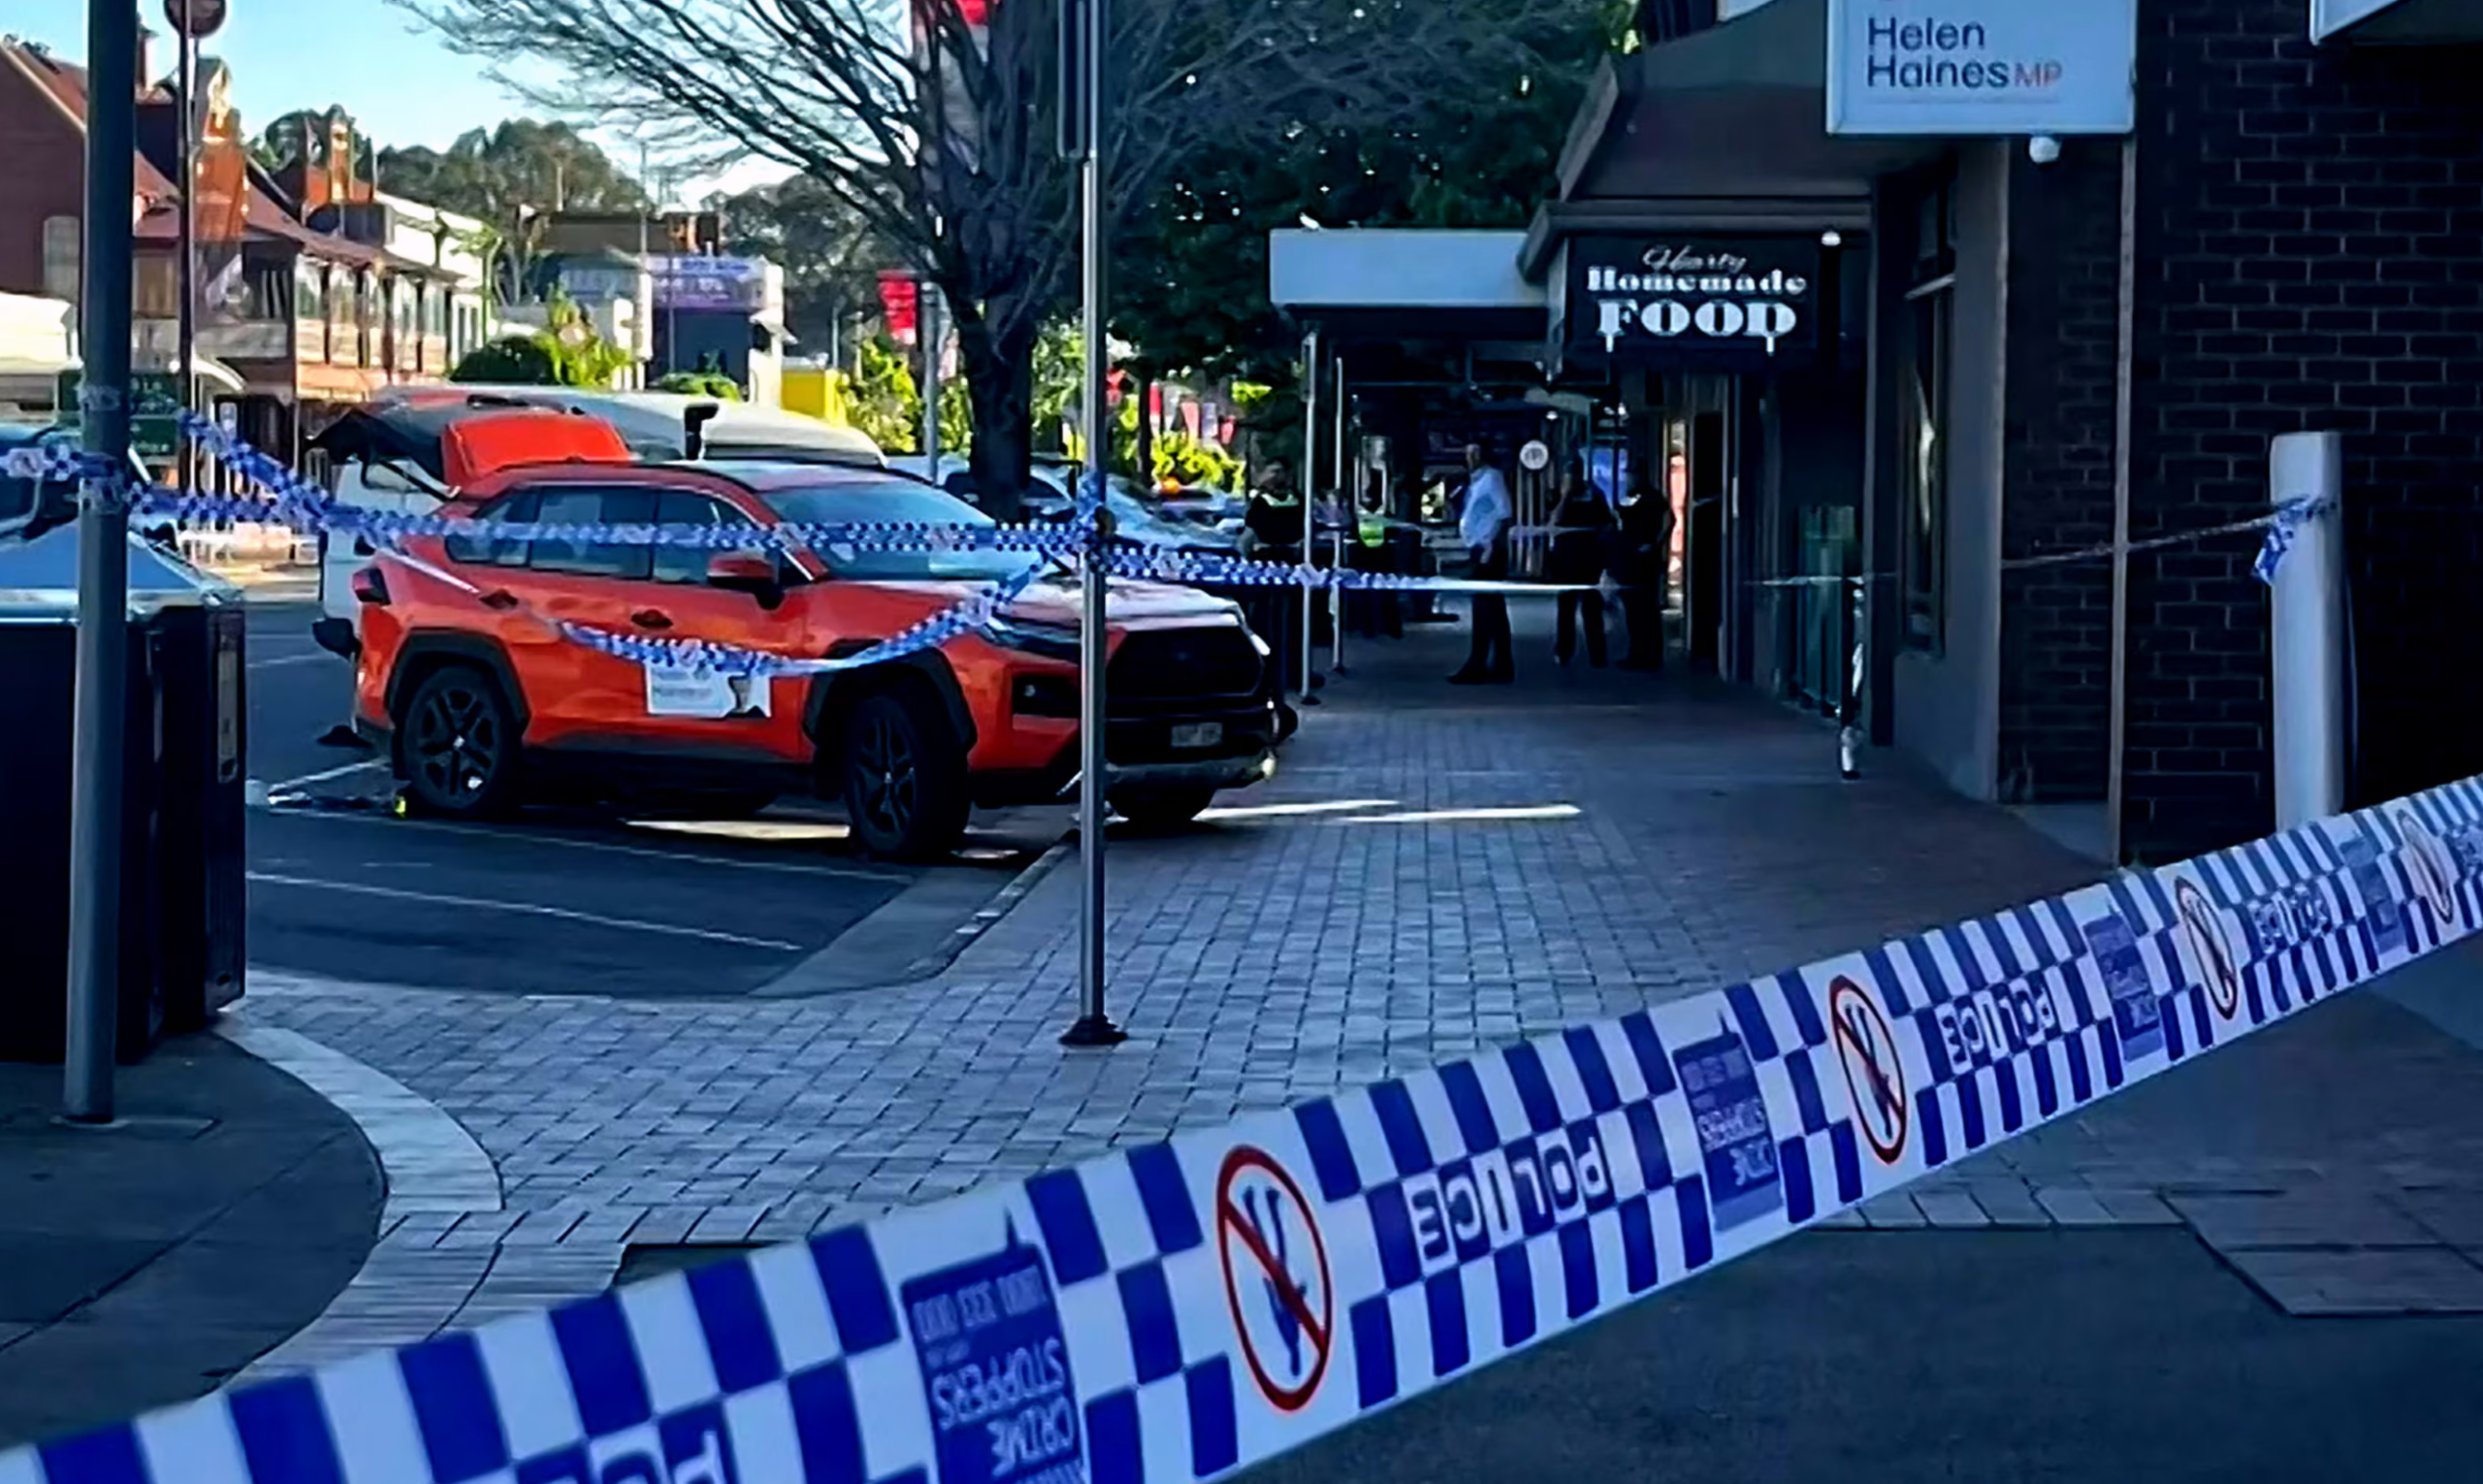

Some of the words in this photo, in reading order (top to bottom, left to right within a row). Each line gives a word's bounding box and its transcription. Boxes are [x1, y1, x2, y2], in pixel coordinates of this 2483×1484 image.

[1868, 16, 1984, 50] Helen
[1867, 54, 2009, 88] Haines
[2014, 59, 2063, 88] MP
[1587, 265, 1807, 294] Homemade
[1596, 298, 1797, 354] FOOD
[1941, 986, 2055, 1065] POLICE
[1411, 1136, 1609, 1261] POLICE
[931, 1336, 1065, 1432] STOPPERS
